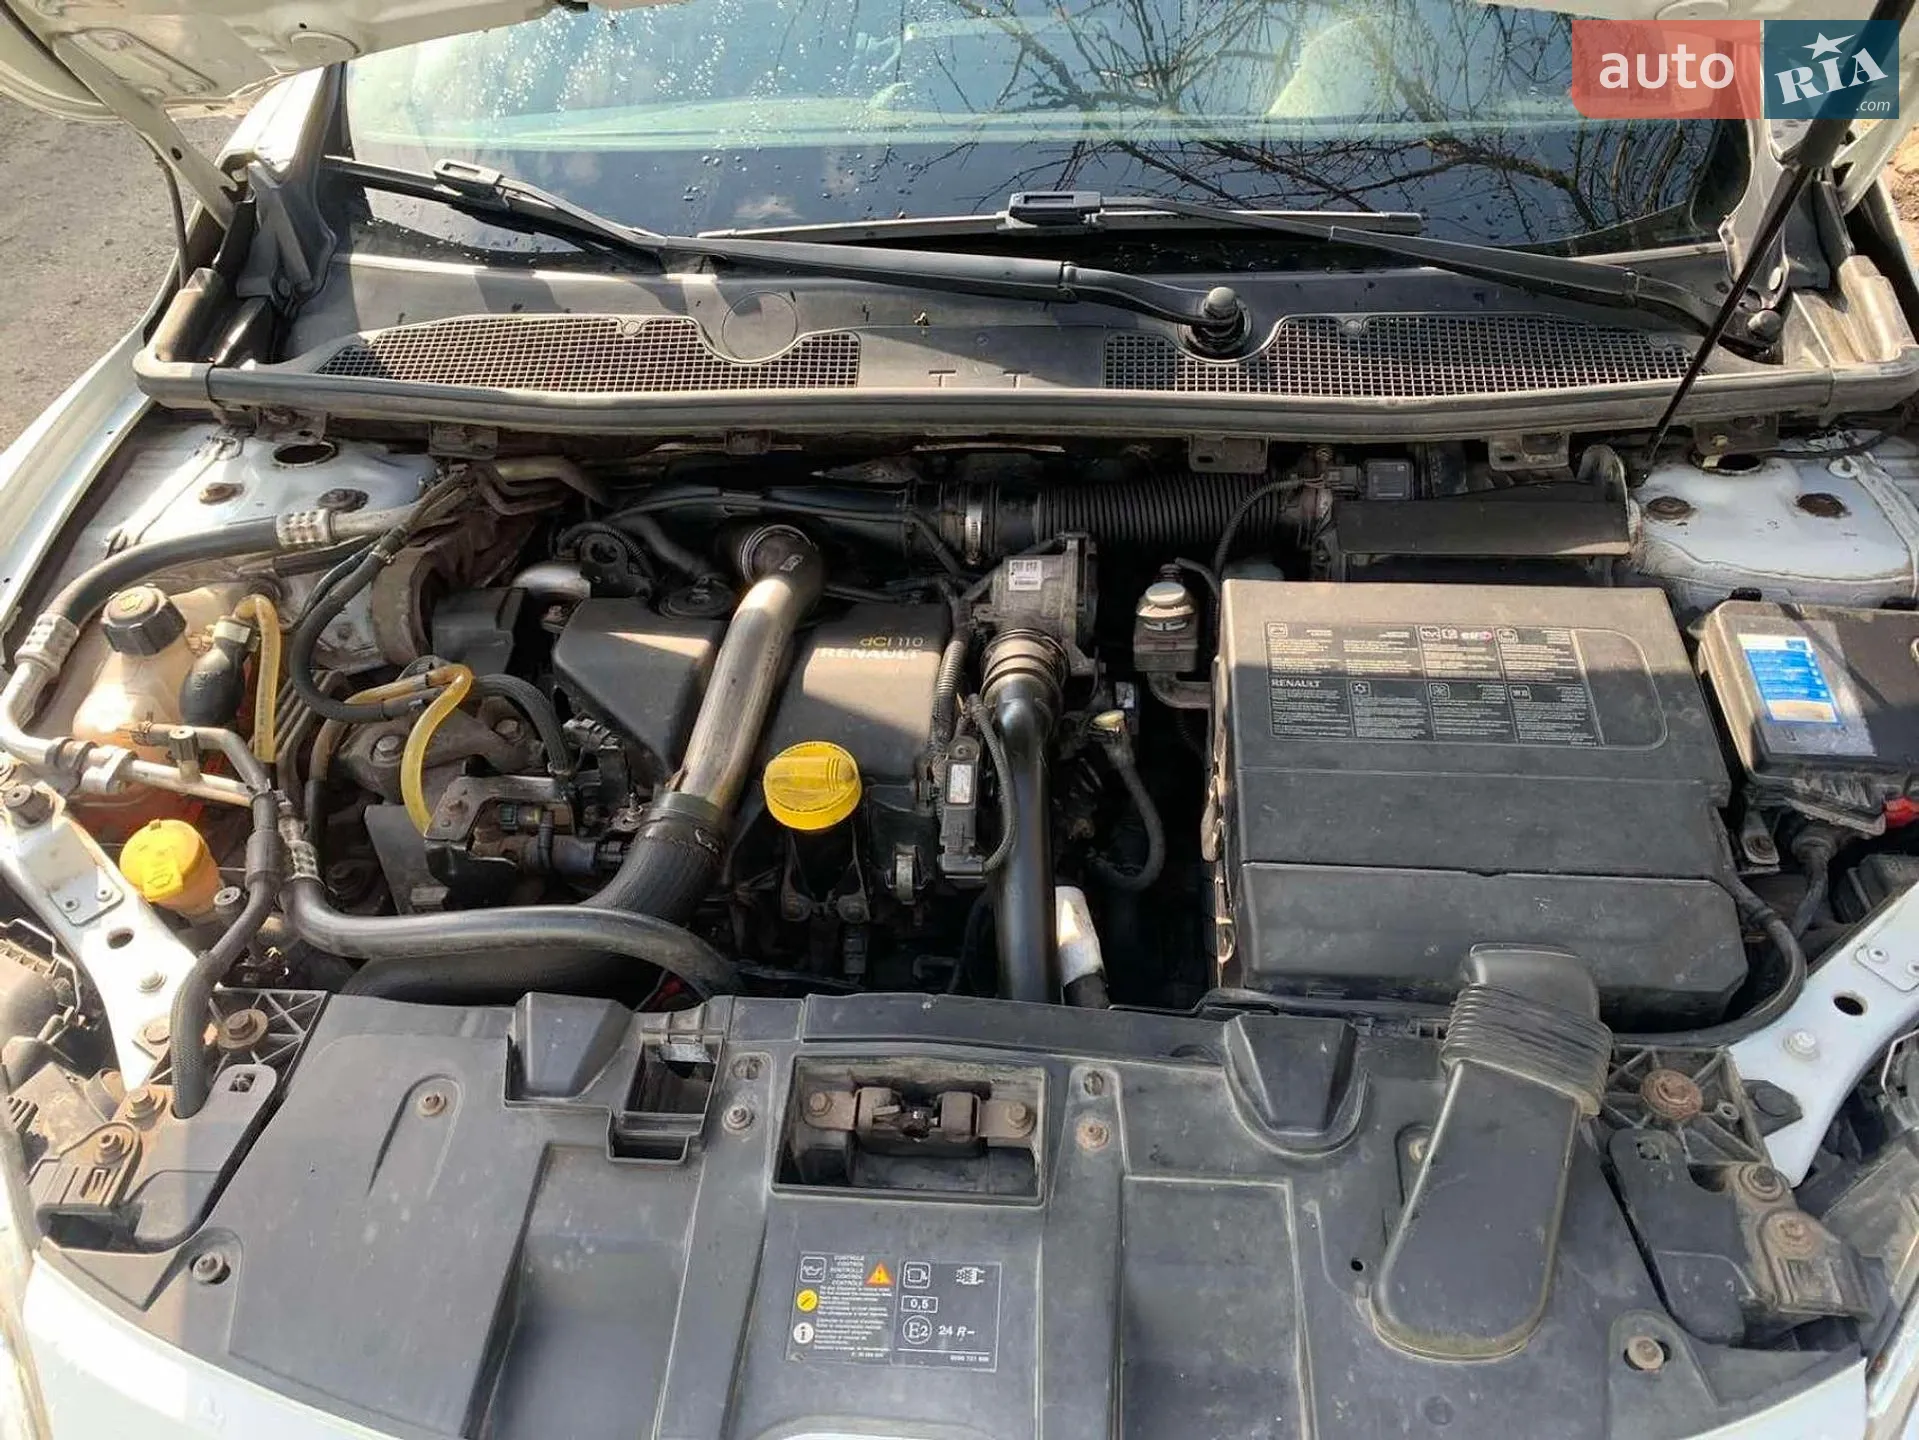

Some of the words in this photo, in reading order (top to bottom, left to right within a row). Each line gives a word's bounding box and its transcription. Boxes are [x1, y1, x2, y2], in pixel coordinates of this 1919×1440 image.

[898, 636, 924, 648] 110
[819, 648, 921, 660] RENAULT
[1271, 679, 1322, 689] RENAULT
[908, 1321, 929, 1339] E2
[938, 1325, 953, 1335] 24
